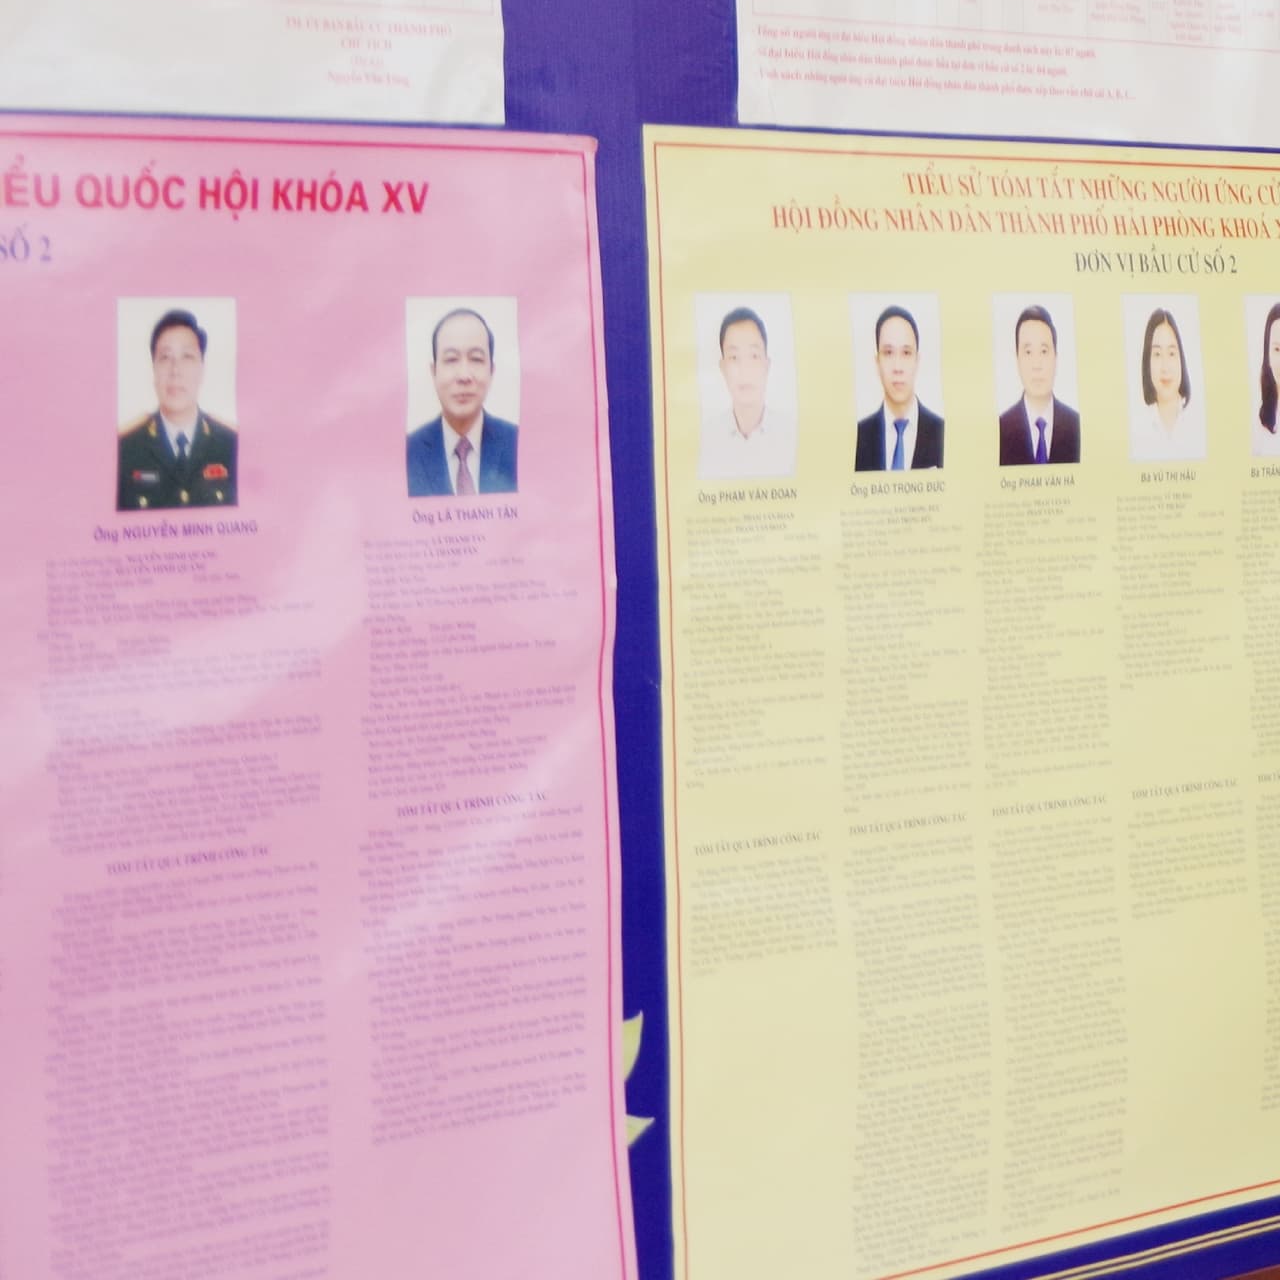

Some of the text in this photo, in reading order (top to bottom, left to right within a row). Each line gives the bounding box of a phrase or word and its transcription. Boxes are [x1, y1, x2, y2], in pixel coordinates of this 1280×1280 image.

[3, 154, 430, 220] ỂU QUỐC HỘI KHÓA XV
[903, 160, 954, 196] TIỂU
[958, 164, 984, 197] SỬ
[987, 169, 1033, 199] TÓM
[1036, 165, 1074, 199] TẮT
[1081, 174, 1147, 203] NHỮNG
[1152, 177, 1210, 205] NGƯỜI
[1214, 176, 1253, 206] ỨNG
[771, 198, 813, 233] HỘI
[817, 193, 878, 231] ĐỒNG
[883, 202, 945, 233] NHÂN
[949, 203, 993, 233] DÂN
[995, 206, 1066, 235] THÀNH
[1070, 204, 1109, 236] PHỐ
[1114, 207, 1148, 236] HẢI
[1153, 210, 1216, 238] PHÒNG
[1220, 211, 1271, 239] KHOÁ
[40, 235, 52, 262] 2
[1073, 246, 1237, 278] ĐƠN VỊ BẦU CỬ SỐ 2
